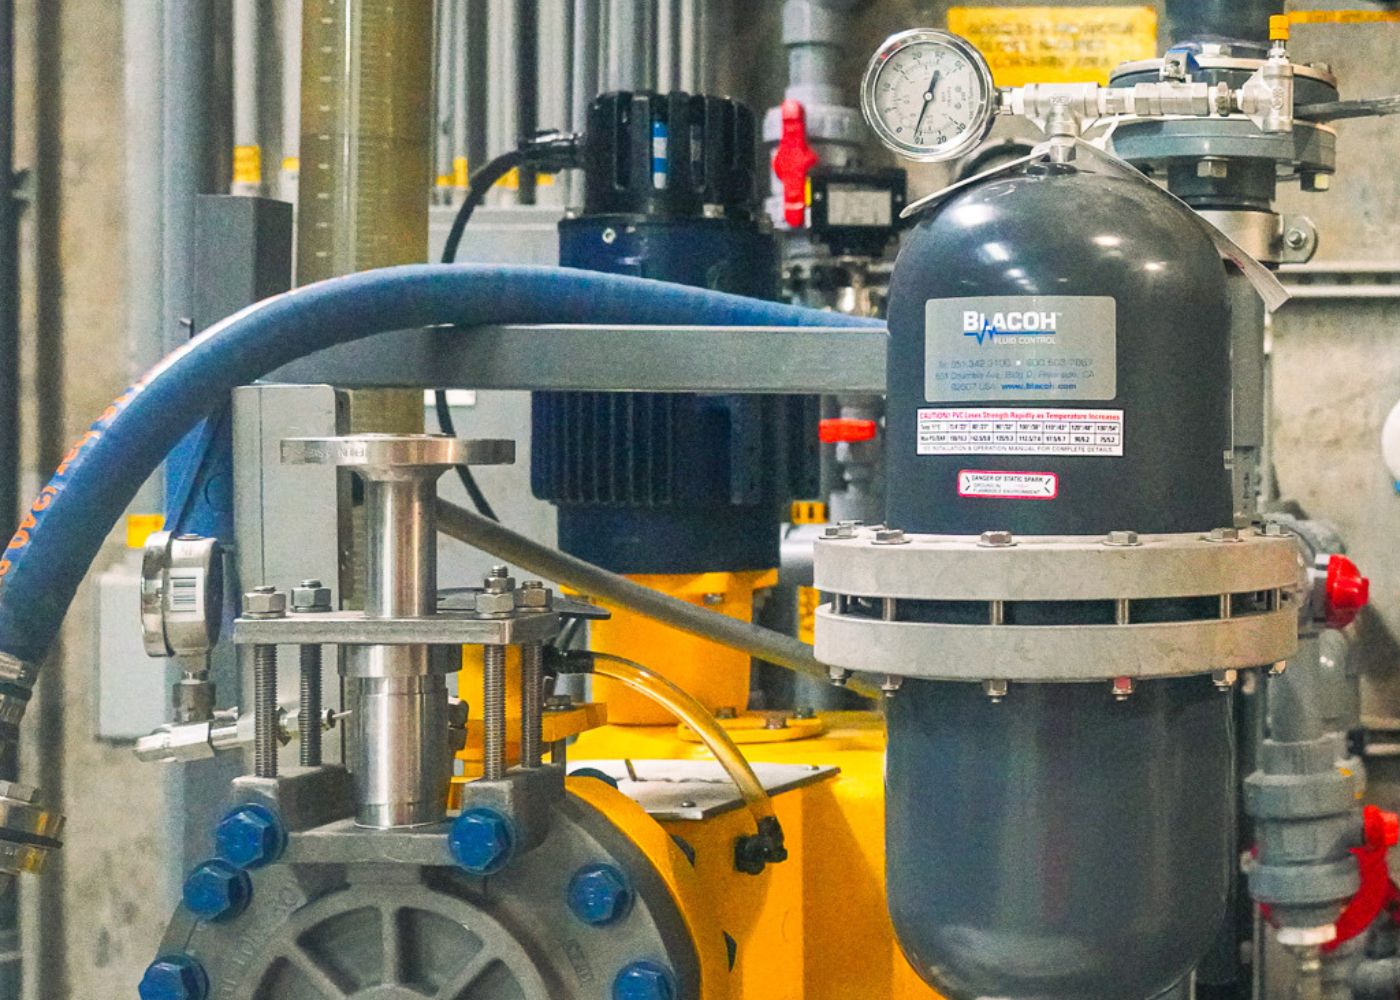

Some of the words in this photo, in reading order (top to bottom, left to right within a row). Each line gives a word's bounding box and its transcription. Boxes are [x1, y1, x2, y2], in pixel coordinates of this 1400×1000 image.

[963, 311, 1057, 331] BLACOH
[994, 336, 1017, 345] FLUID
[1019, 336, 1056, 345] CONTROL
[952, 412, 964, 420] PVC
[983, 412, 1009, 421] Strength
[1010, 412, 1035, 421] Rapidly
[1046, 412, 1087, 421] Temperature
[1088, 413, 1120, 421] Increases
